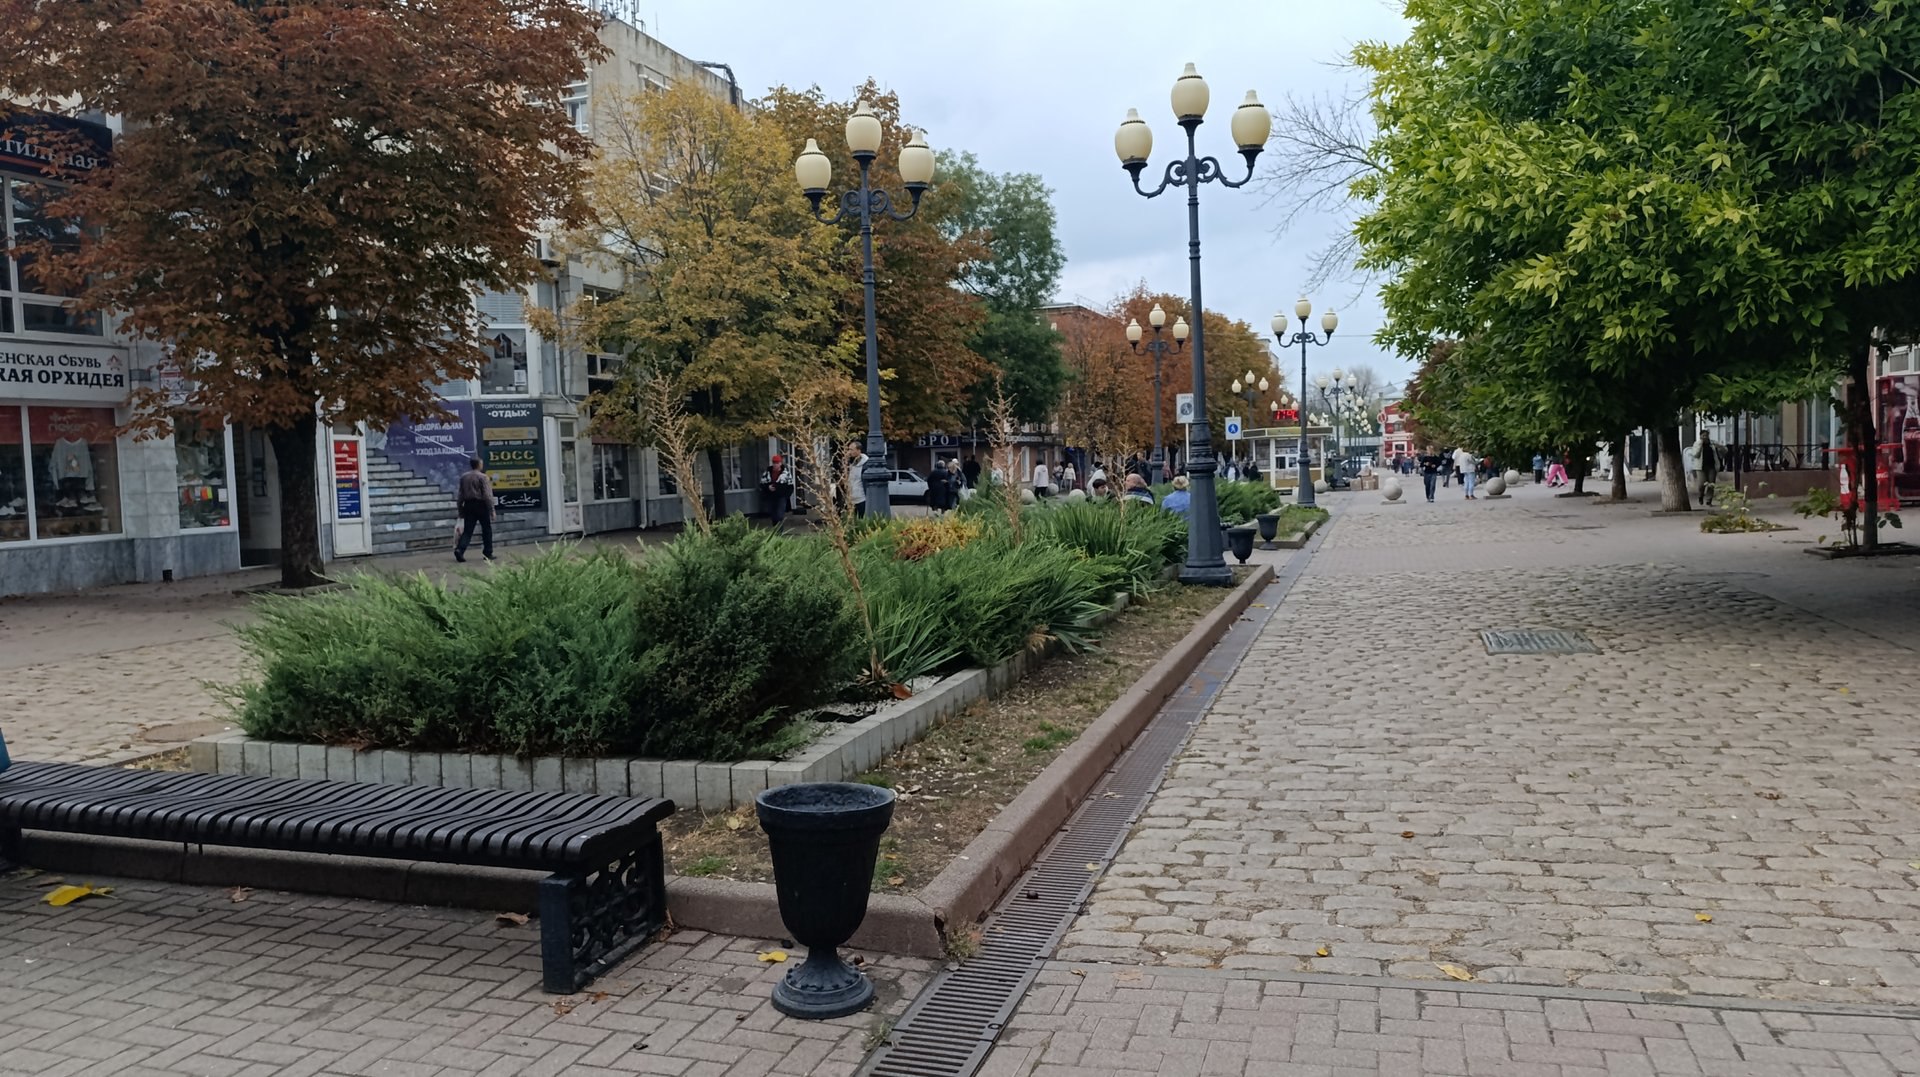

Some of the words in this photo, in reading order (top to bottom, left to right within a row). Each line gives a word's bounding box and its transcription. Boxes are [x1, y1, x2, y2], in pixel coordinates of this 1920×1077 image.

[0, 138, 99, 169] тильная
[38, 369, 124, 388] ОРХИДЕЯ
[491, 410, 527, 418] ОТДЫХ
[415, 435, 453, 444] КОСМЕТИКА
[489, 449, 535, 461] БОСС
